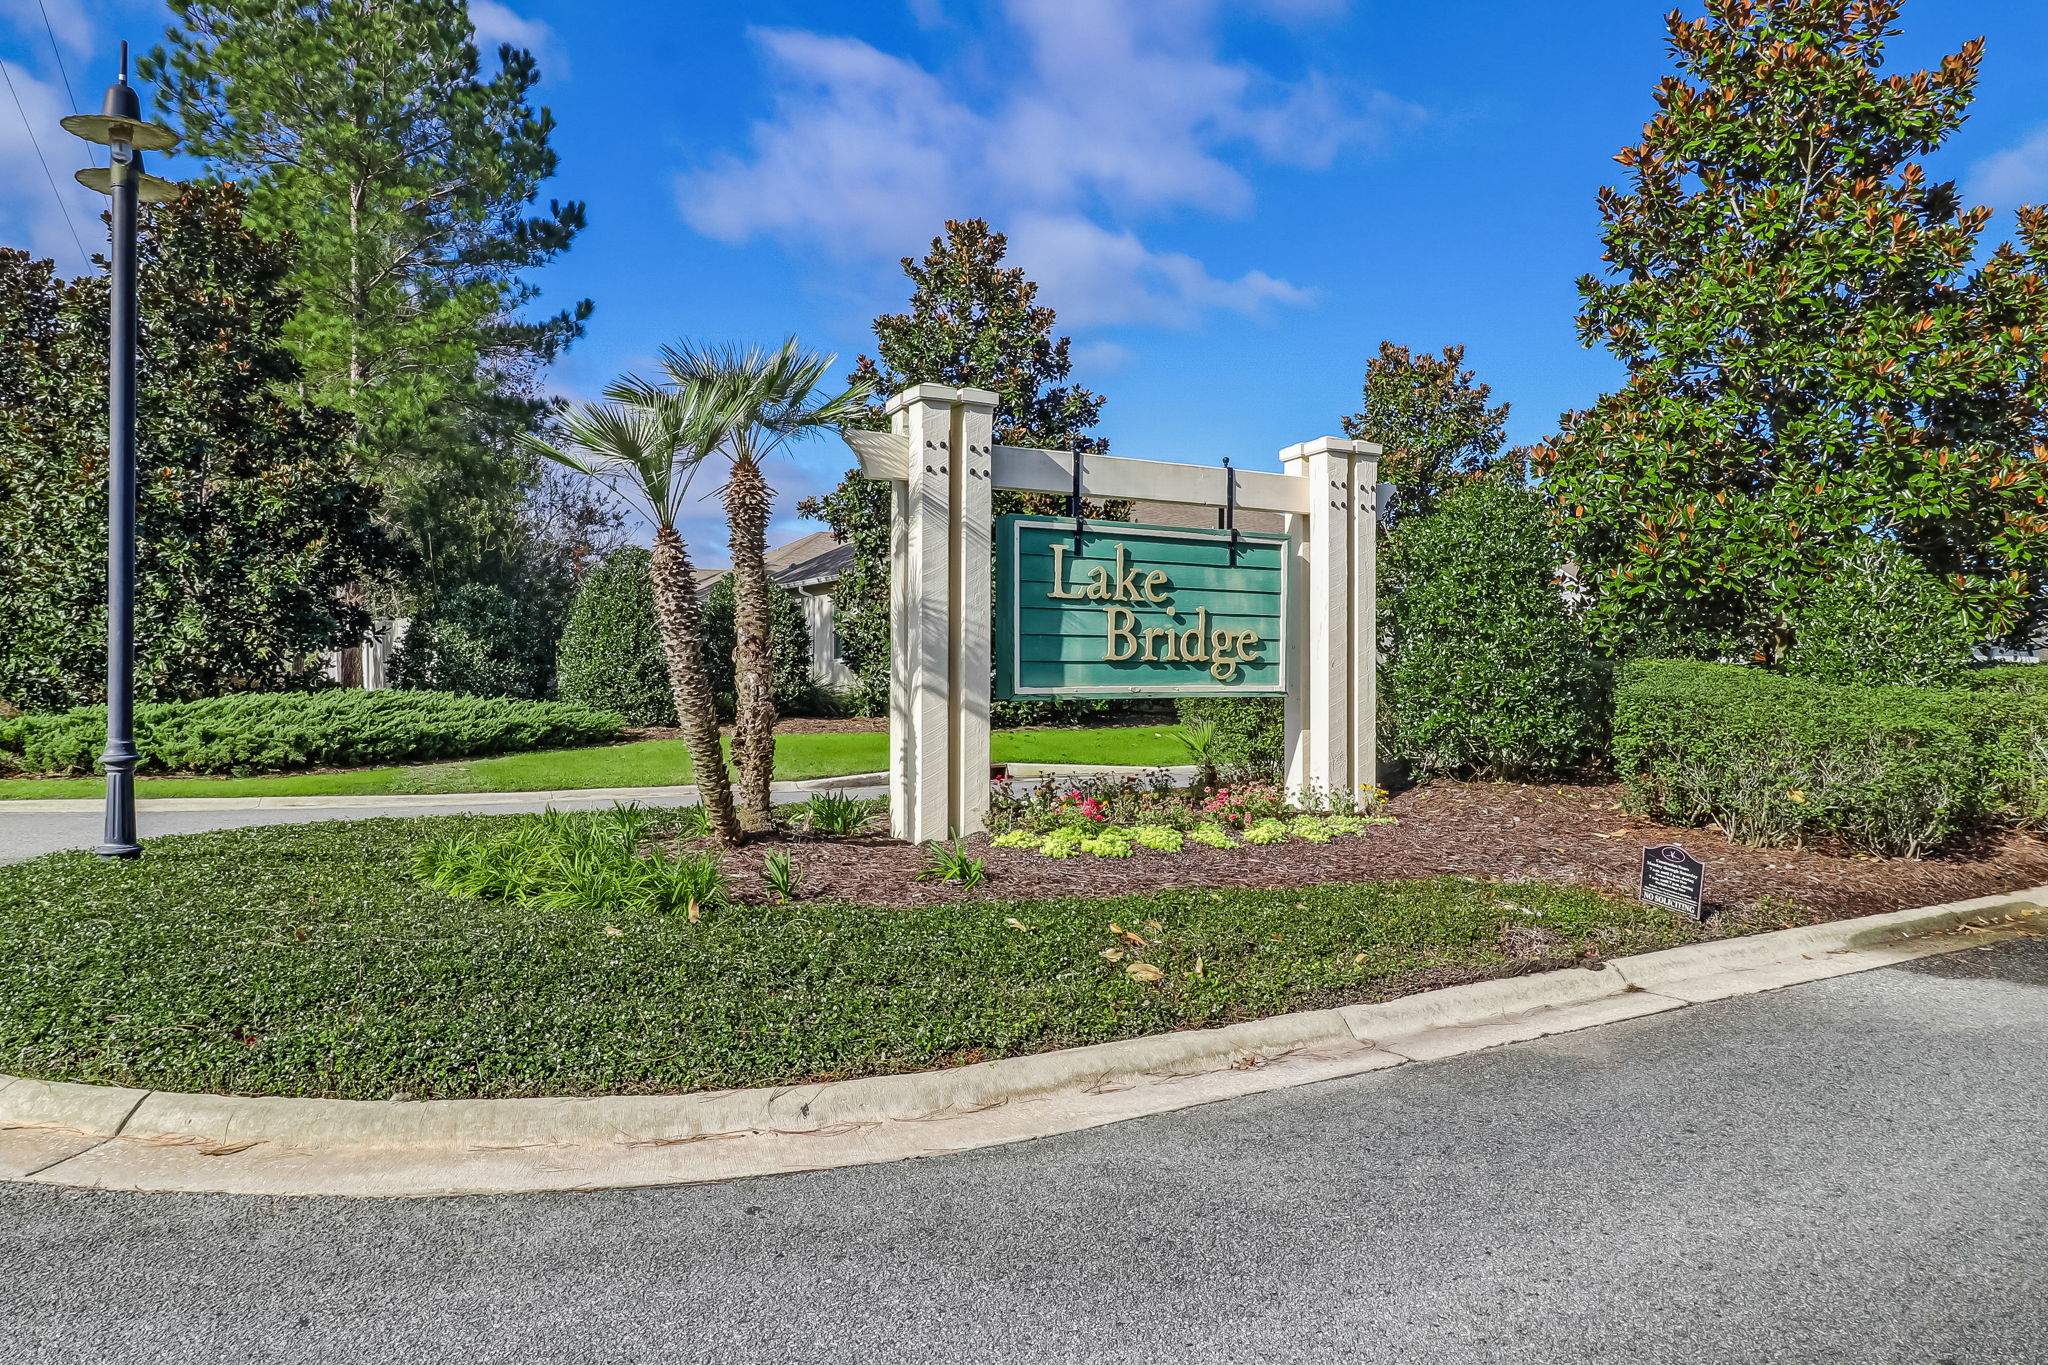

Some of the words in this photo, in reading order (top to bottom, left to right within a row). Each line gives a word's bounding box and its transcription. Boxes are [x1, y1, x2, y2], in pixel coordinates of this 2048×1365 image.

[1047, 543, 1168, 603] Lake
[1101, 606, 1260, 680] Bridge
[1647, 861, 1662, 869] Monday
[1644, 891, 1654, 900] NO
[1655, 895, 1694, 913] SOLICITING
